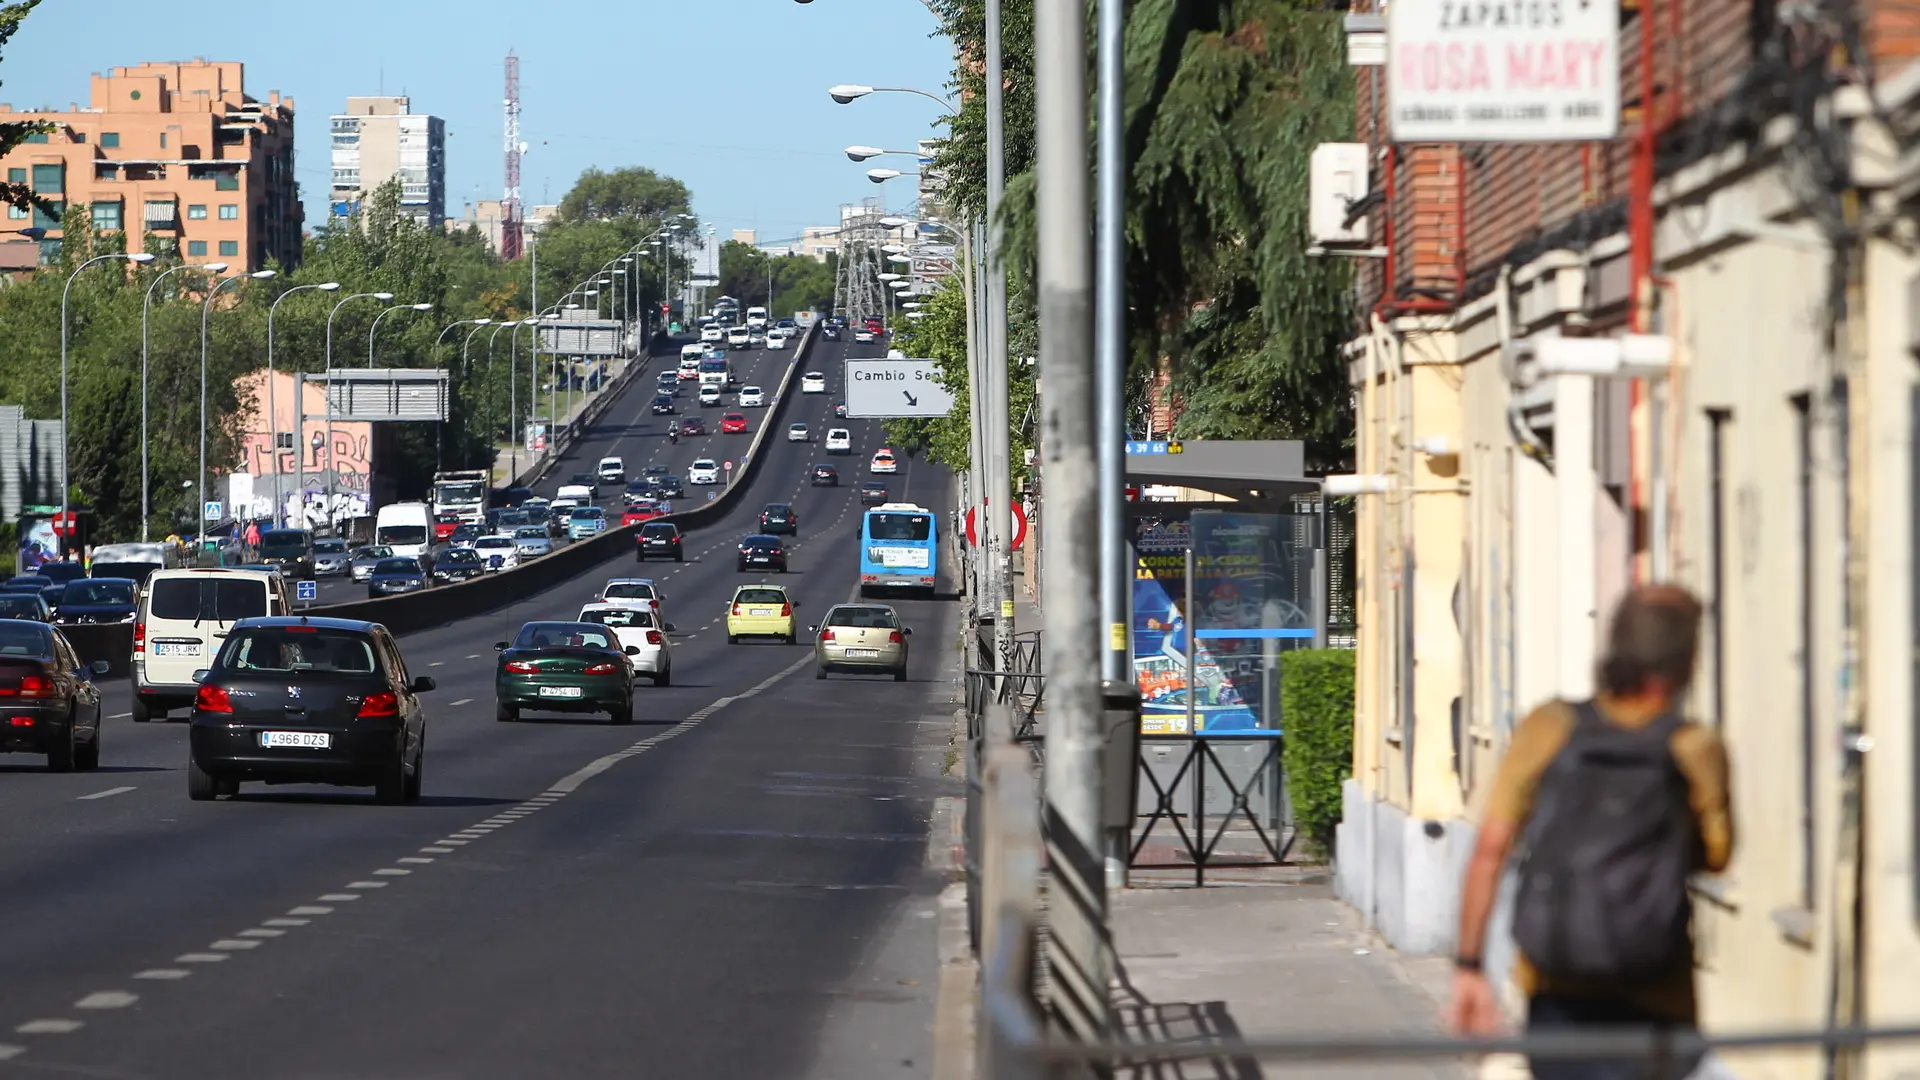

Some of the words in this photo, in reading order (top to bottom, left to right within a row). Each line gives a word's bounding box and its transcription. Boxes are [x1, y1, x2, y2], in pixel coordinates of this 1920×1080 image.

[1439, 0, 1564, 30] ZAPATOS
[1399, 41, 1492, 92] ROSA
[1506, 39, 1606, 91] MARY
[855, 370, 905, 380] Cambio
[1136, 443, 1148, 453] 39
[1153, 443, 1164, 453] 65
[1138, 556, 1190, 567] CONOC
[1136, 568, 1154, 580] LA
[271, 735, 300, 744] 4966
[304, 736, 325, 746] DZS
